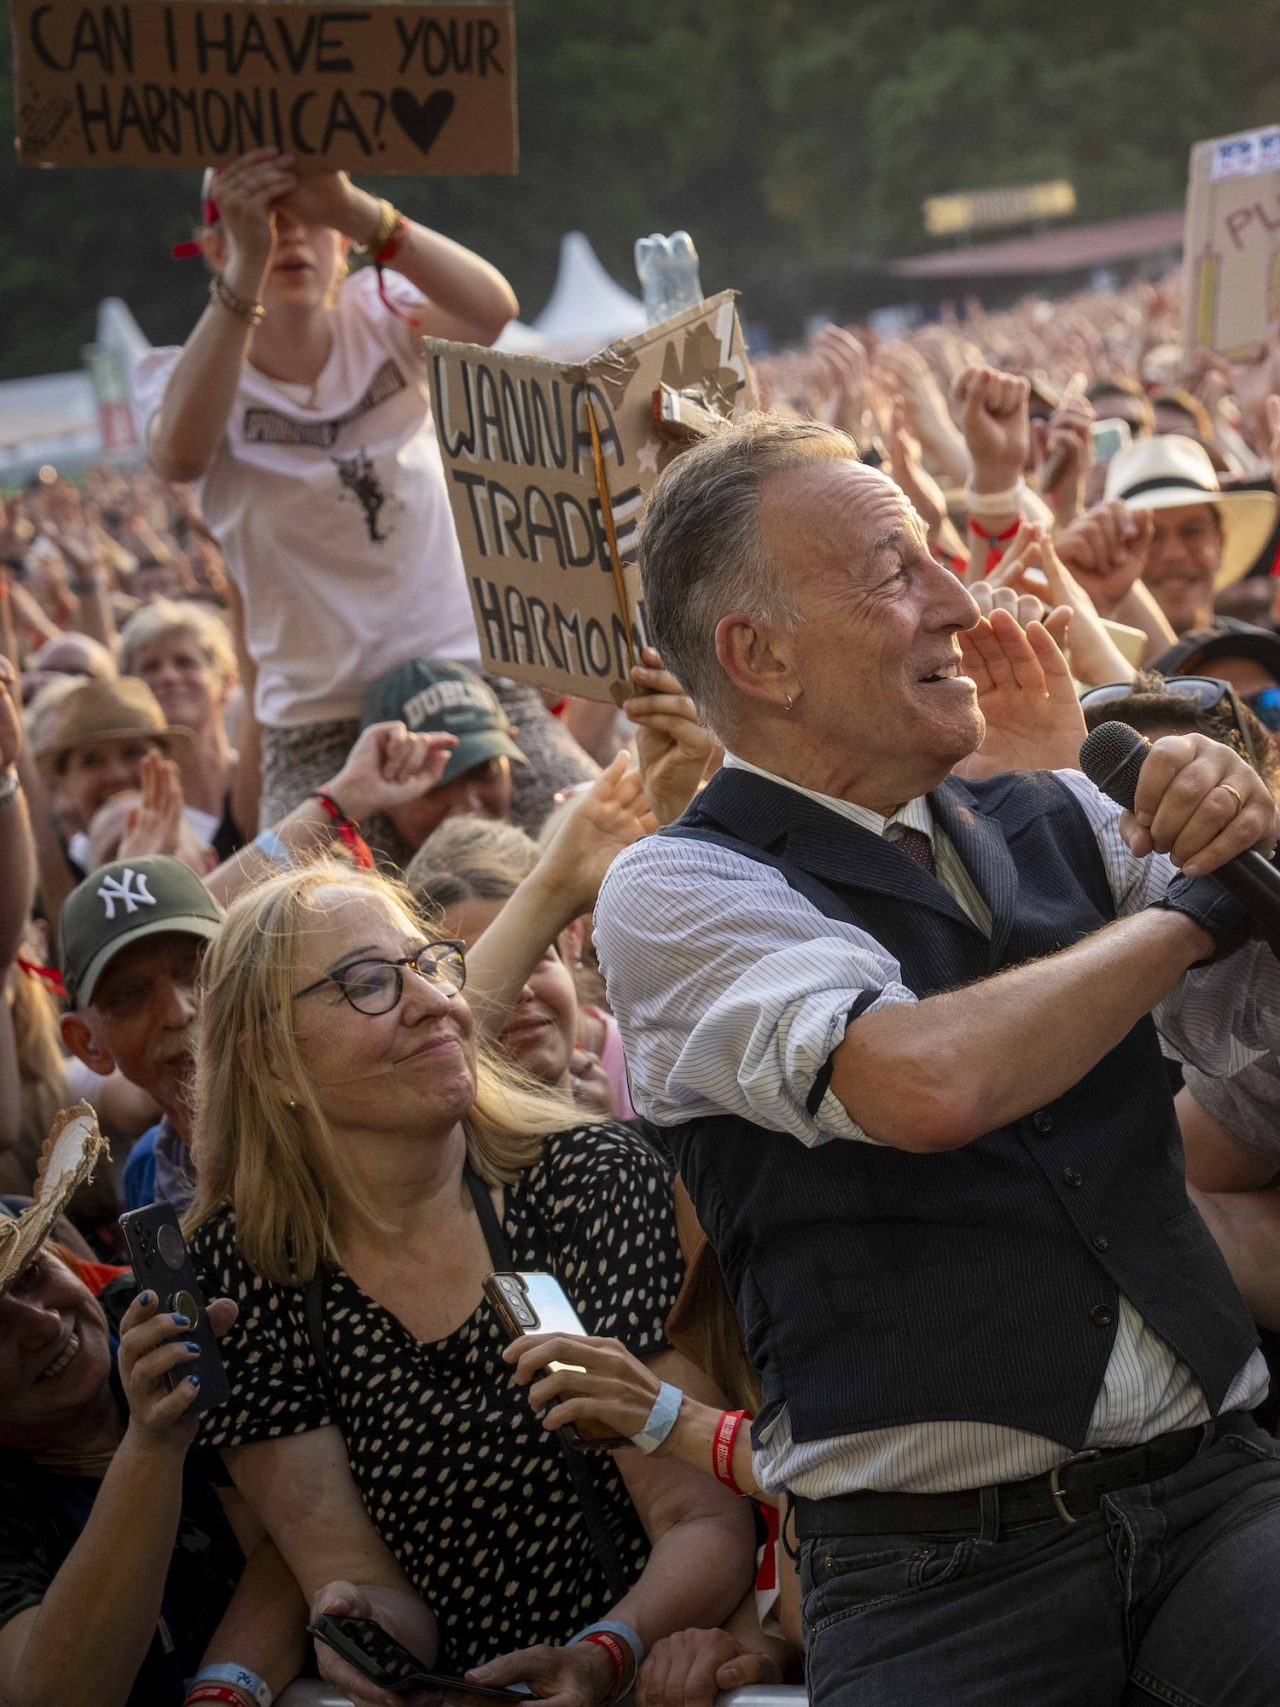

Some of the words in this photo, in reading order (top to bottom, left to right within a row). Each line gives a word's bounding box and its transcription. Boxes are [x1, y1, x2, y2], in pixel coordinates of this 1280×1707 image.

[30, 5, 134, 75] CAN
[164, 7, 177, 73] I
[196, 11, 373, 75] HAVE
[394, 15, 505, 78] YOUR
[75, 80, 387, 156] HARMONICA?
[434, 355, 625, 474] WANNA
[452, 468, 643, 572] TRADE
[97, 867, 157, 920] NY
